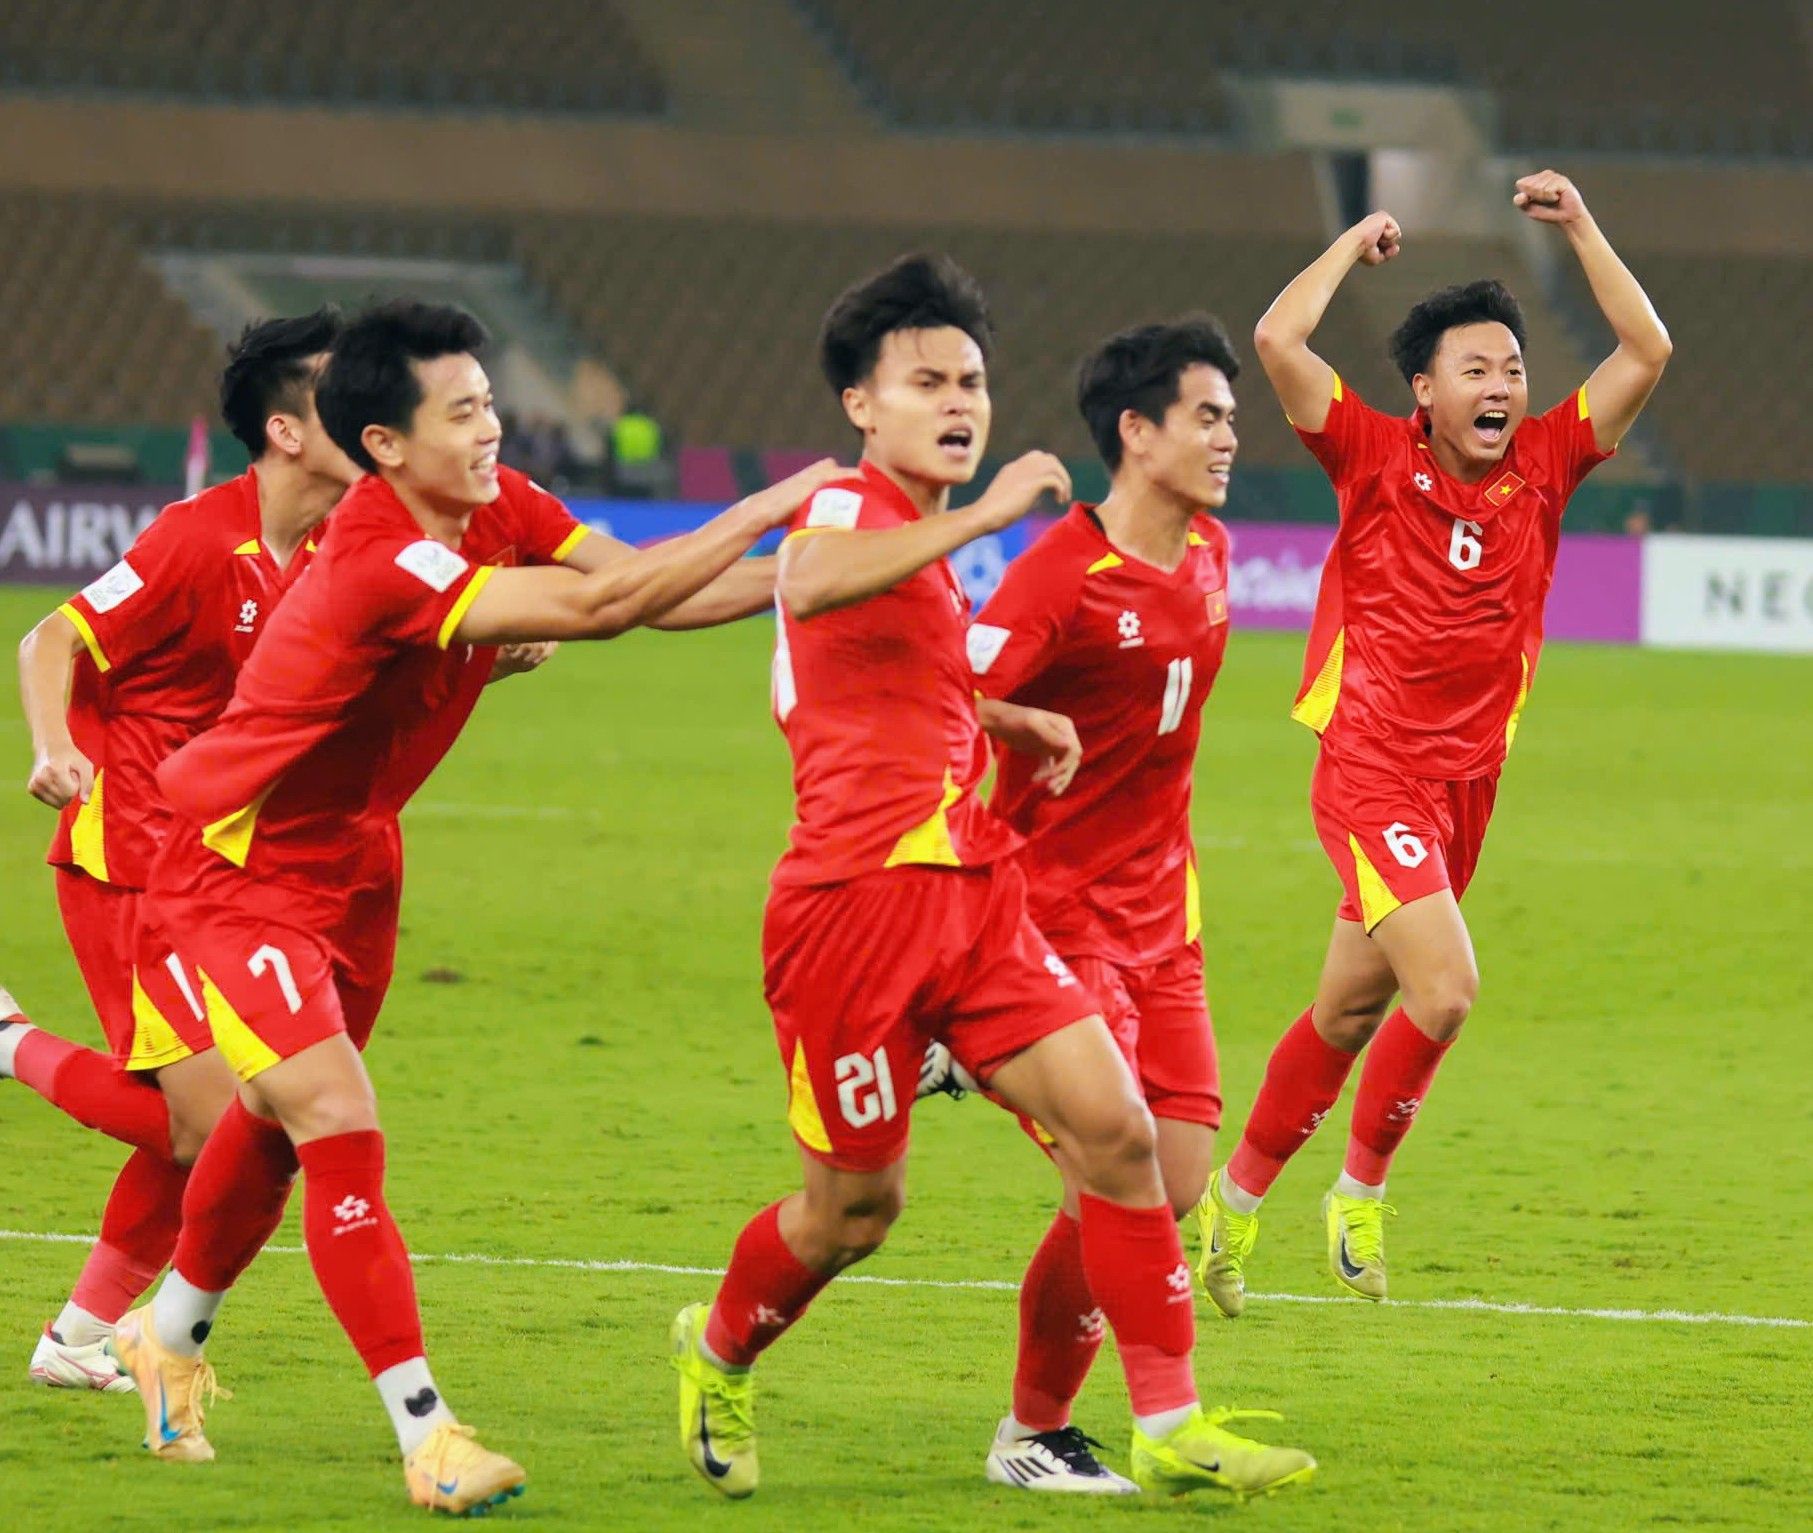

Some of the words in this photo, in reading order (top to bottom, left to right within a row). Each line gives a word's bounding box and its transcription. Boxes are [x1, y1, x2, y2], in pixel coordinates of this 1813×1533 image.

[1448, 518, 1483, 571] 6
[1704, 569, 1813, 621] NE
[1158, 656, 1193, 736] 11
[1382, 821, 1429, 869] 6
[247, 944, 303, 1015] 7
[834, 1045, 898, 1129] 21
